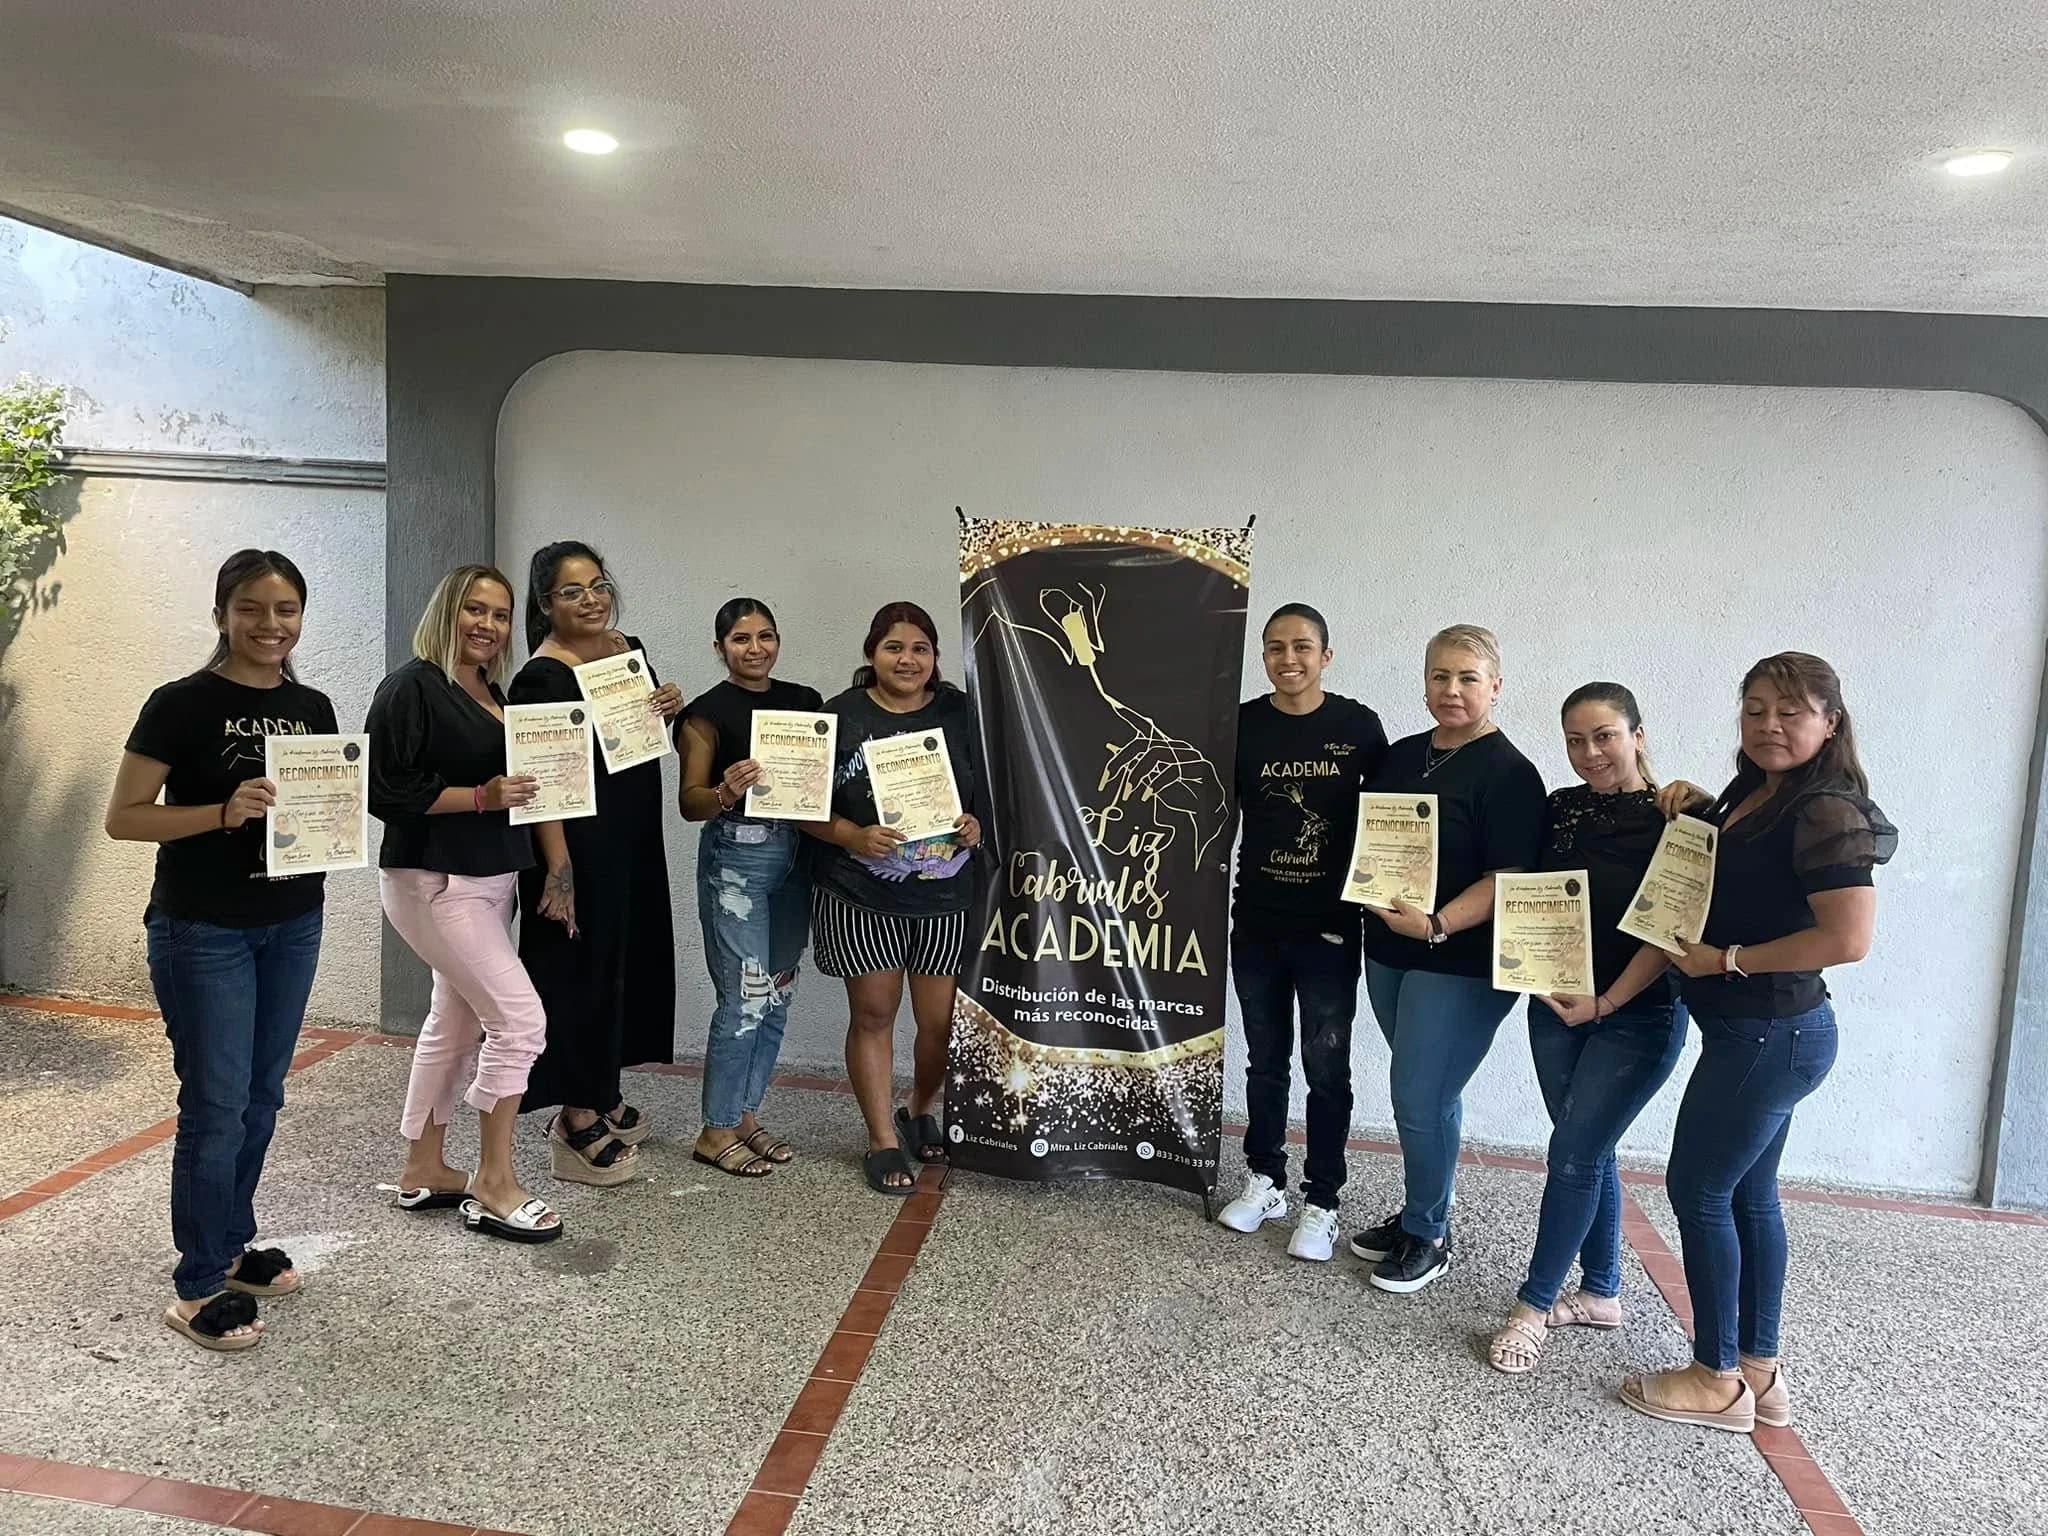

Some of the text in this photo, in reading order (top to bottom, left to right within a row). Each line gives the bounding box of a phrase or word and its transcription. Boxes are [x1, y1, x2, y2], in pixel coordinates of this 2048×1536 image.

[589, 675, 646, 698] RECONOCIMIENTO
[515, 727, 585, 745] RECONOCIMIENTO
[760, 733, 827, 749] RECONOCIMIENTO
[875, 752, 942, 775] RECONOCIMIENTO
[1260, 761, 1341, 777] ACADEMIA
[279, 765, 359, 782] RECONOCIMIENTO
[1365, 818, 1430, 834] RECONOCIMIENTO
[1076, 806, 1169, 873] Liz
[1009, 850, 1169, 919] Cabriales
[1505, 899, 1581, 914] RECONOCIMIENTO
[980, 907, 1208, 976] ACADEMIA
[982, 977, 1204, 1016] Distribución de las marcas
[1014, 1007, 1159, 1031] más reconocidas
[966, 1134, 1018, 1151] Liz Cabriales
[1050, 1141, 1128, 1152] Mtra. Liz Cabriales
[1192, 1158, 1203, 1168] 33
[1204, 1159, 1216, 1168] 99
